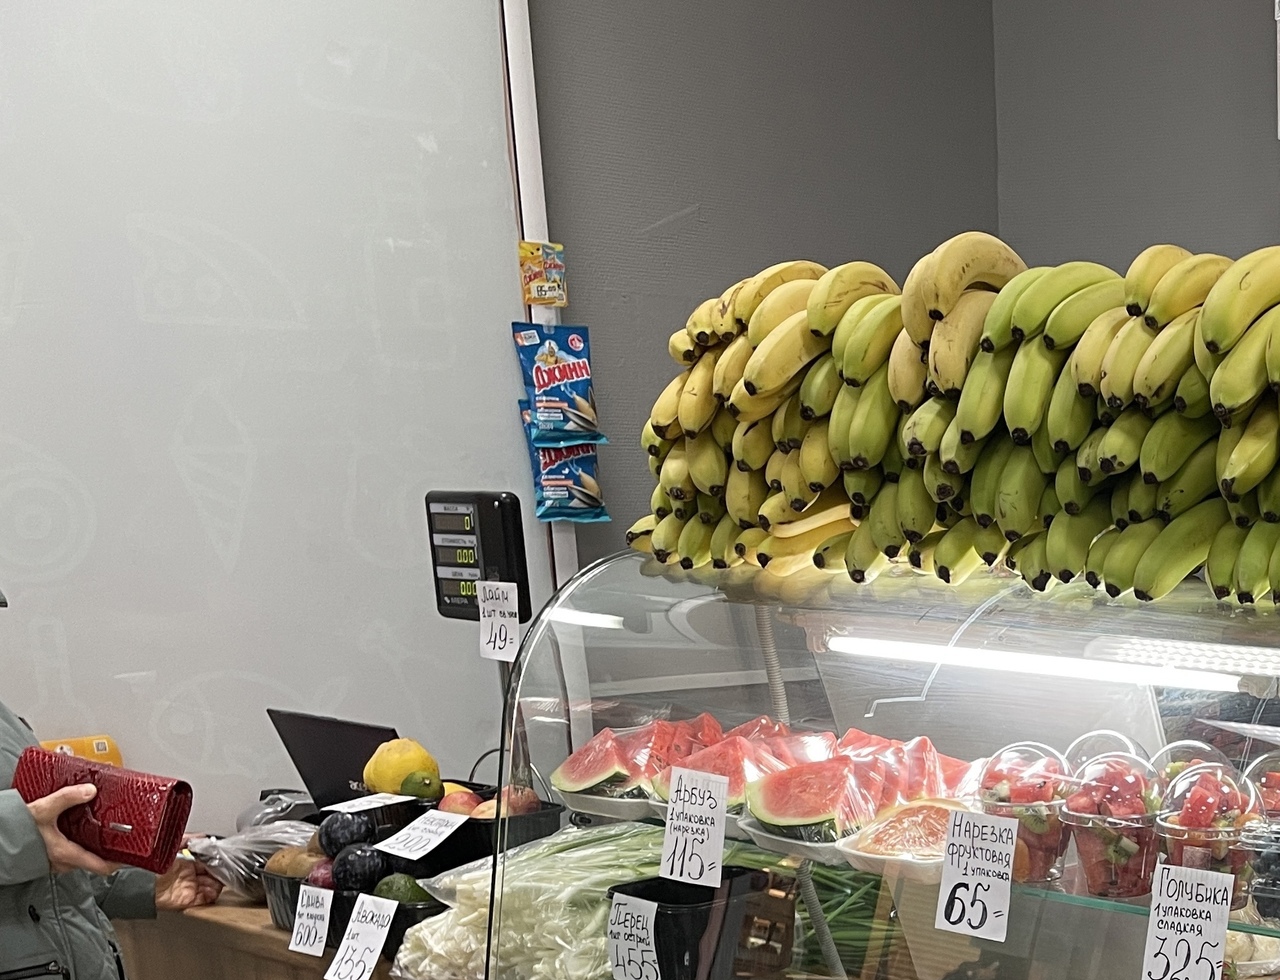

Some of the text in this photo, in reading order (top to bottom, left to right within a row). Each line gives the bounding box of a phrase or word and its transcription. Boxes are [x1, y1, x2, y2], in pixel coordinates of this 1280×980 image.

[534, 359, 590, 393] ДЖИНН
[671, 775, 717, 814] АРБУЗ
[952, 812, 1014, 847] НАРЕЗКА
[948, 842, 1011, 868] ФРУКТОВАЯ
[1160, 867, 1229, 906] ГОЛУБИКА
[352, 901, 391, 930] АВОКАДО
[610, 903, 650, 937] ПЕРЕЦ
[1157, 919, 1203, 937] СЛАДКАЯ
